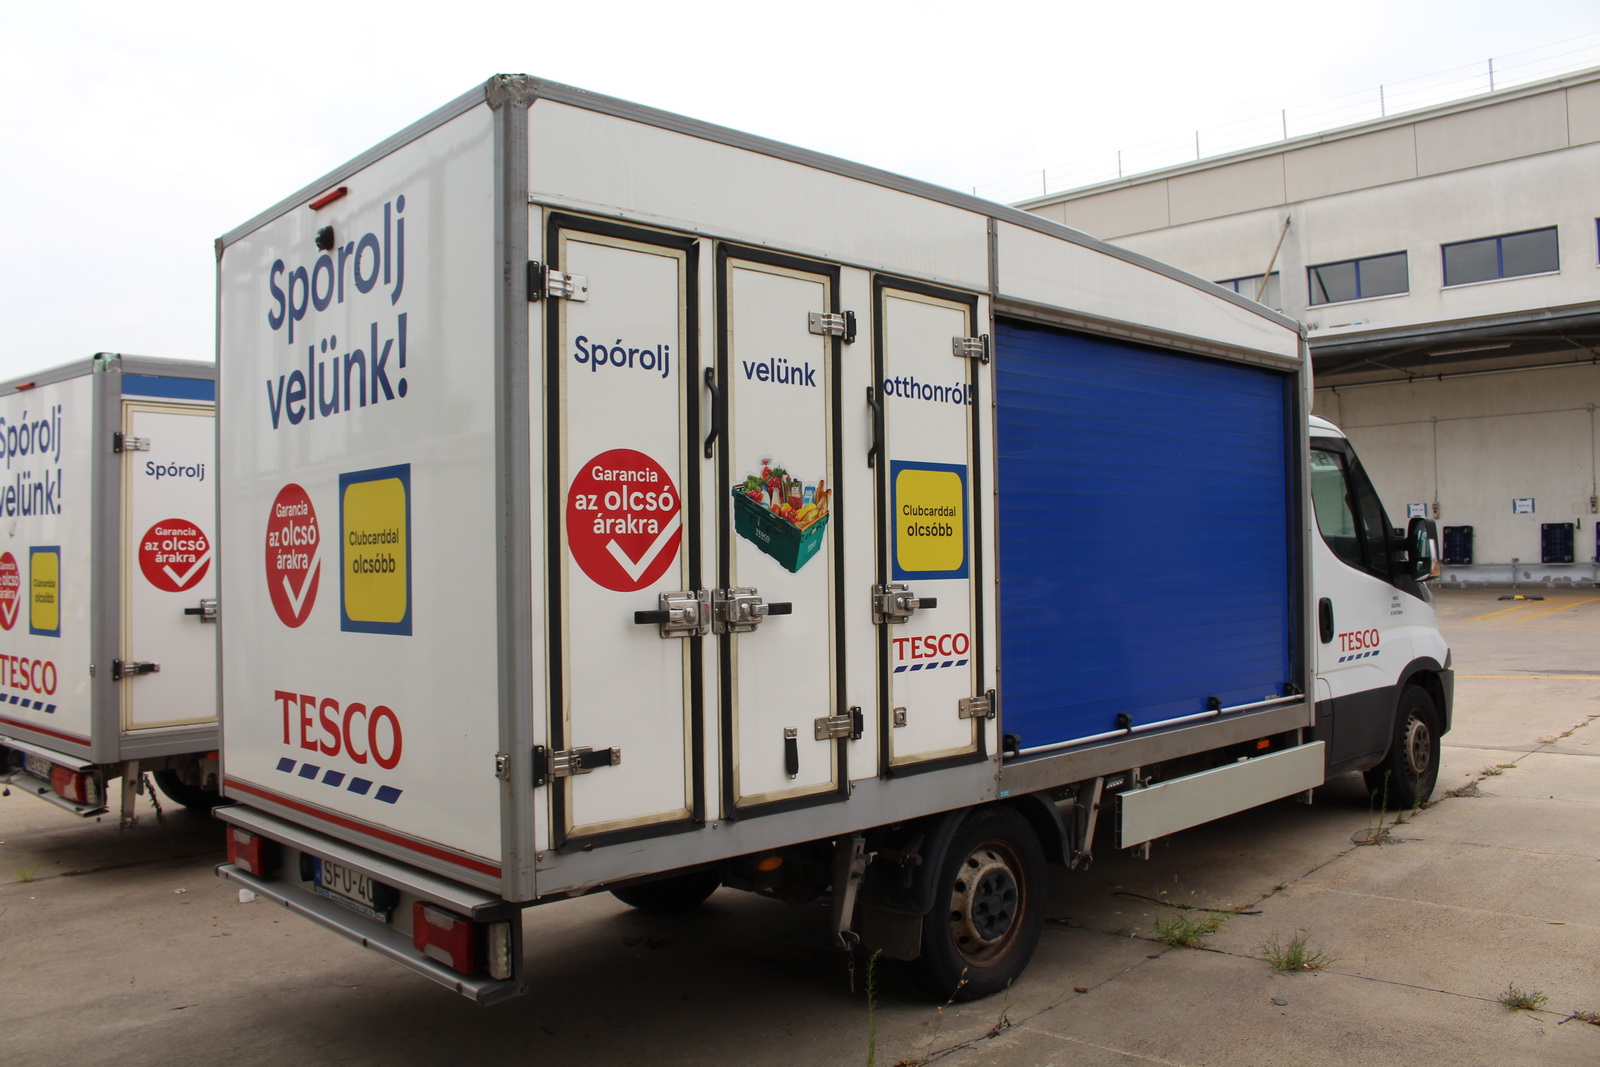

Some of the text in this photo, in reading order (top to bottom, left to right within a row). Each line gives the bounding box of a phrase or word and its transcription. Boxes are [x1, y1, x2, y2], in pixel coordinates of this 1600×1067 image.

[574, 335, 670, 379] Spórolj
[266, 312, 408, 430] velünk!
[742, 357, 816, 387] velünk
[883, 376, 973, 405] otthonról!
[145, 461, 205, 482] Spórolj
[592, 465, 658, 483] Garancia
[575, 484, 674, 511] az olcsó
[275, 500, 308, 518] Garancia
[902, 504, 956, 517] Clubcarddal
[155, 527, 197, 536] Garancia
[269, 517, 317, 547] az olcsó
[593, 512, 659, 534] árakra
[907, 522, 953, 537] olcsóbb
[144, 537, 206, 551] az olcsó
[349, 528, 399, 546] Clubcarddal
[155, 551, 196, 563] árakra
[276, 549, 309, 570] árakra
[352, 553, 396, 574] olcsóbb
[893, 632, 969, 660] TESCO
[1338, 628, 1380, 652] TESCO
[0, 653, 58, 696] TESCO
[274, 689, 403, 770] TESCO
[324, 860, 375, 902] SFU-40
